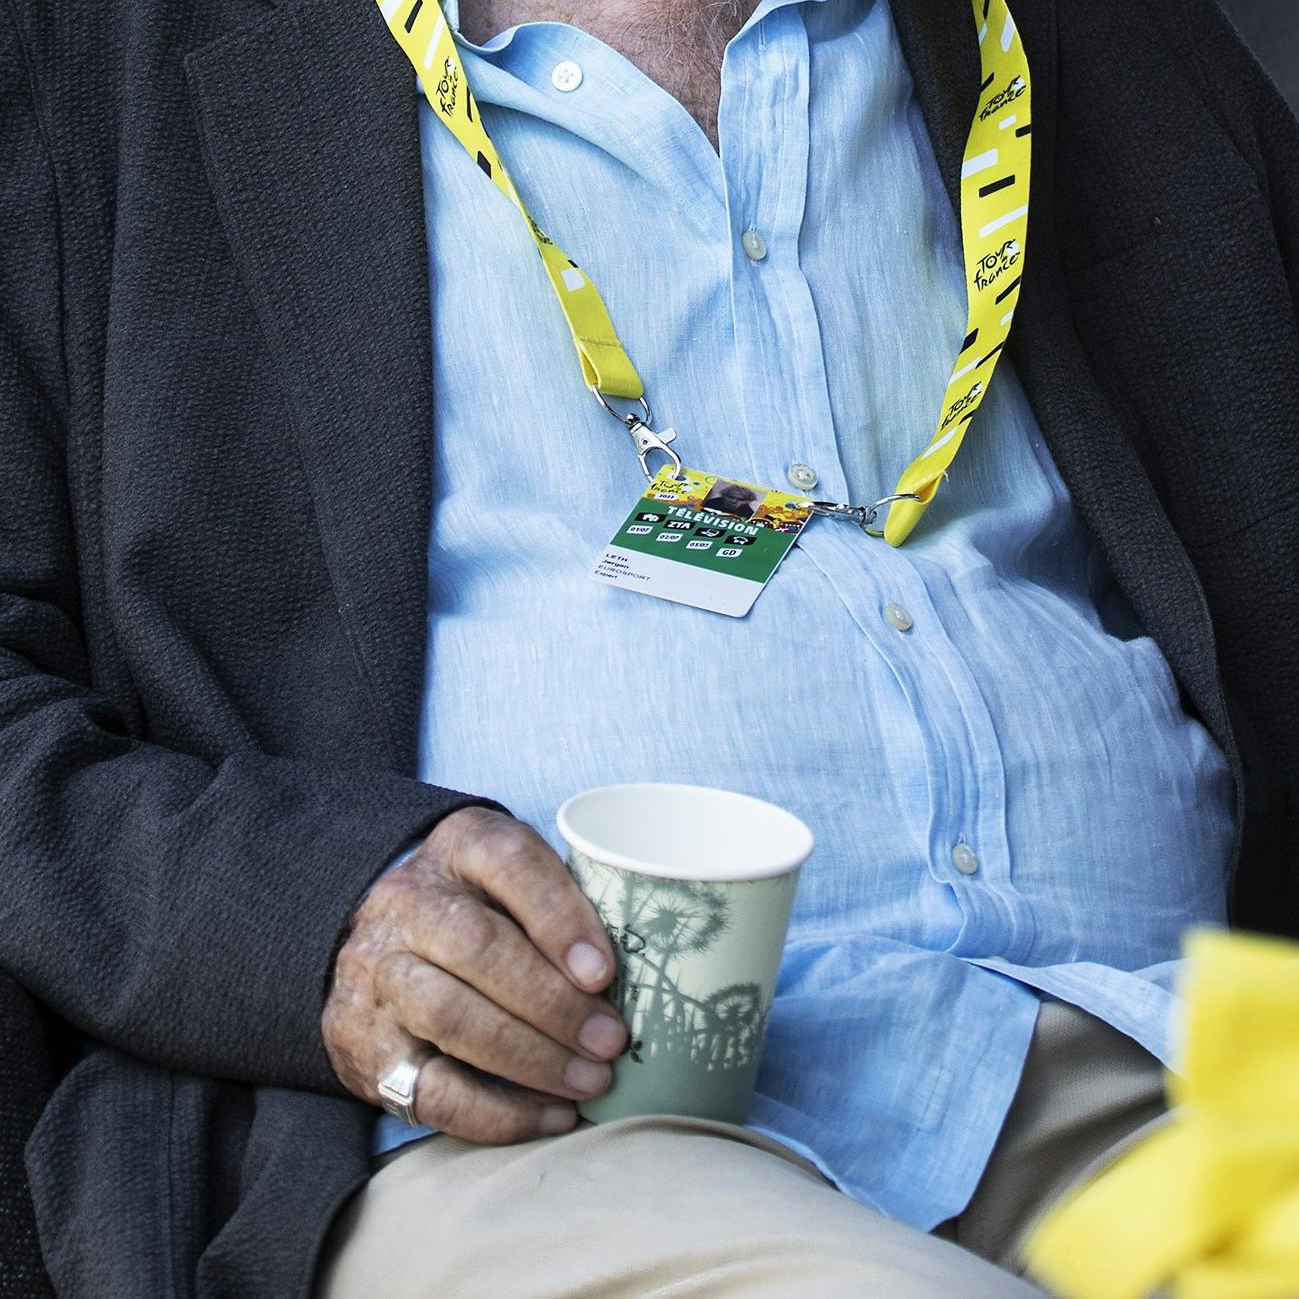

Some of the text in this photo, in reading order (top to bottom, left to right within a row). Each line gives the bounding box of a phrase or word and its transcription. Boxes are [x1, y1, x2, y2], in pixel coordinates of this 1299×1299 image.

[667, 505, 760, 536] TÉLÉVISION
[668, 521, 691, 530] ZTA
[605, 553, 629, 562] LETH
[598, 564, 652, 581] EUROSPORT
